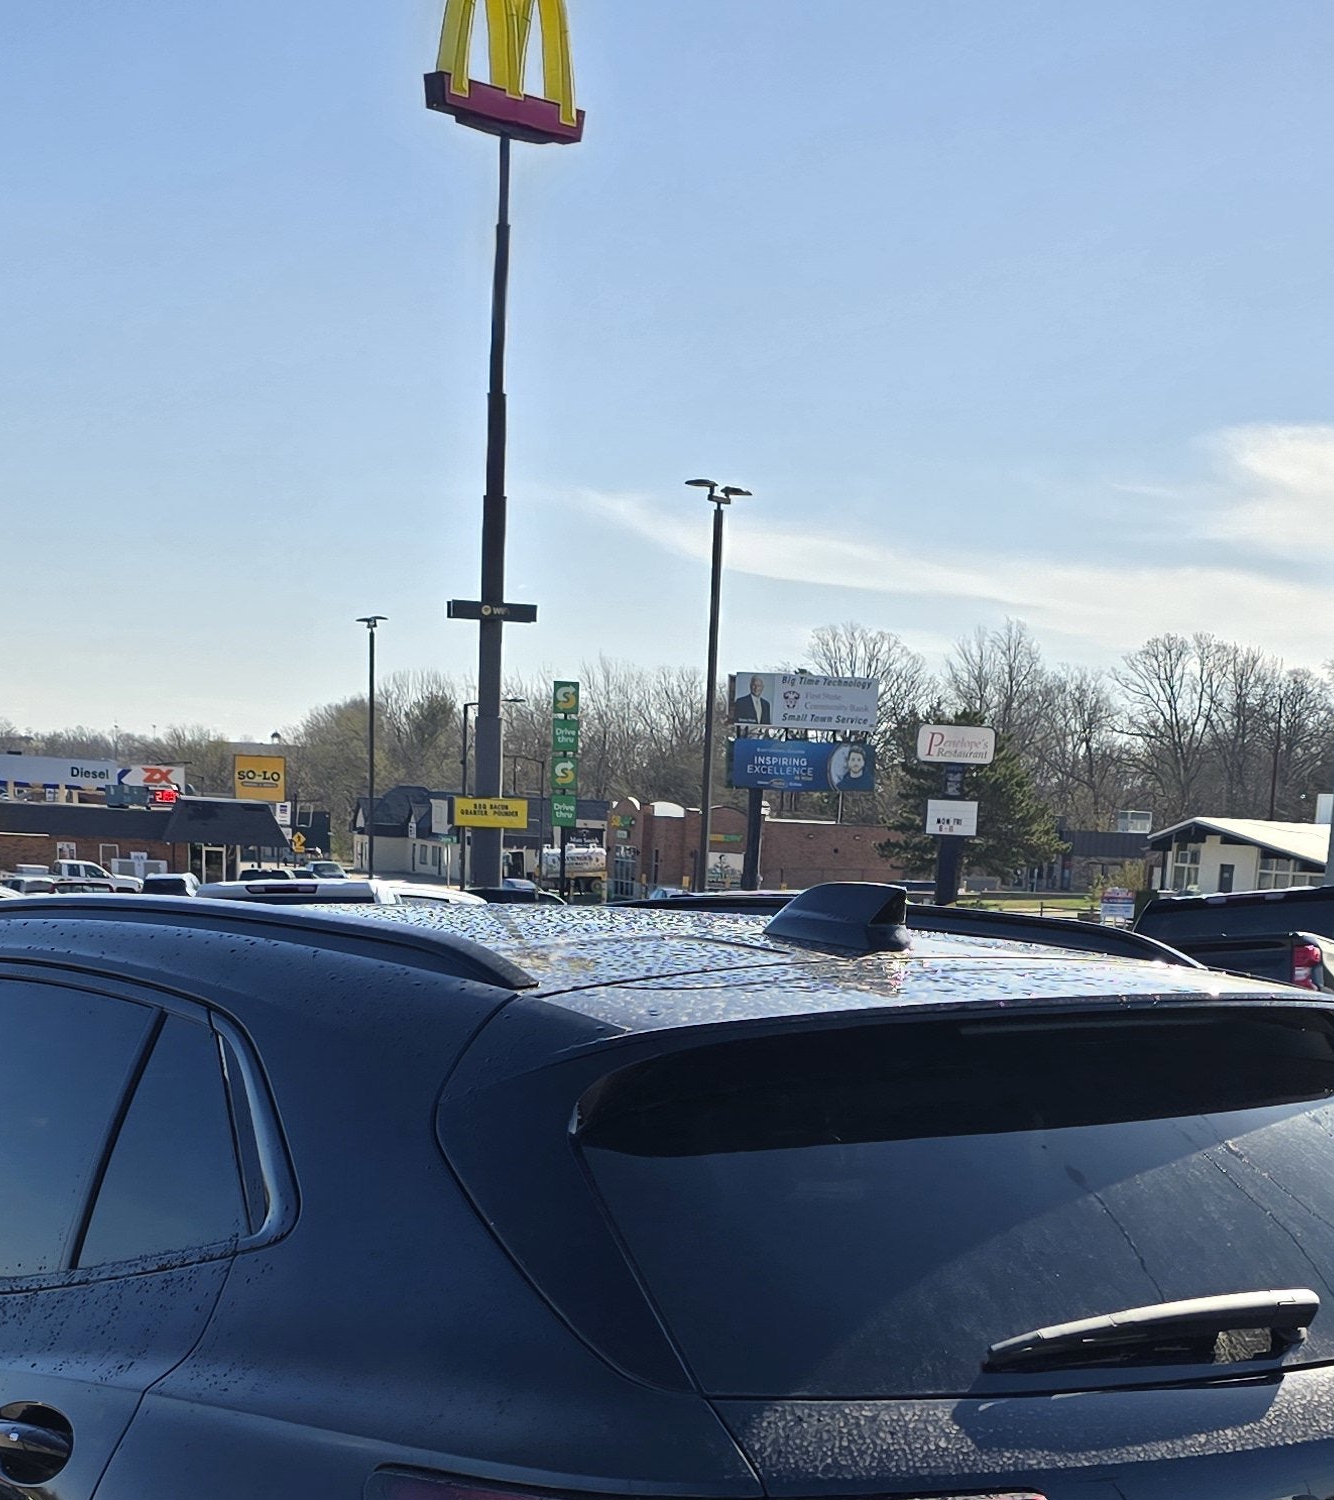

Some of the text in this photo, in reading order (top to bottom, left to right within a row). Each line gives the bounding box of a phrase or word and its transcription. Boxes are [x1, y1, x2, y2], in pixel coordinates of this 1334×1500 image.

[781, 675, 873, 690] Big Time Technology
[781, 712, 869, 725] Small Town Service
[555, 727, 576, 737] Drive
[557, 736, 575, 744] thru
[925, 731, 989, 757] Penelope's
[936, 747, 988, 759] Restaurant
[754, 755, 807, 766] INSPIRING
[70, 766, 110, 780] Diesel
[237, 769, 281, 782] SO-LO
[747, 764, 814, 776] EXCELLENCE
[473, 803, 487, 811] BBQ
[554, 802, 575, 812] Drive
[460, 809, 519, 818] QUARTER POUNDER
[555, 811, 573, 819] thru
[936, 817, 950, 826] MON
